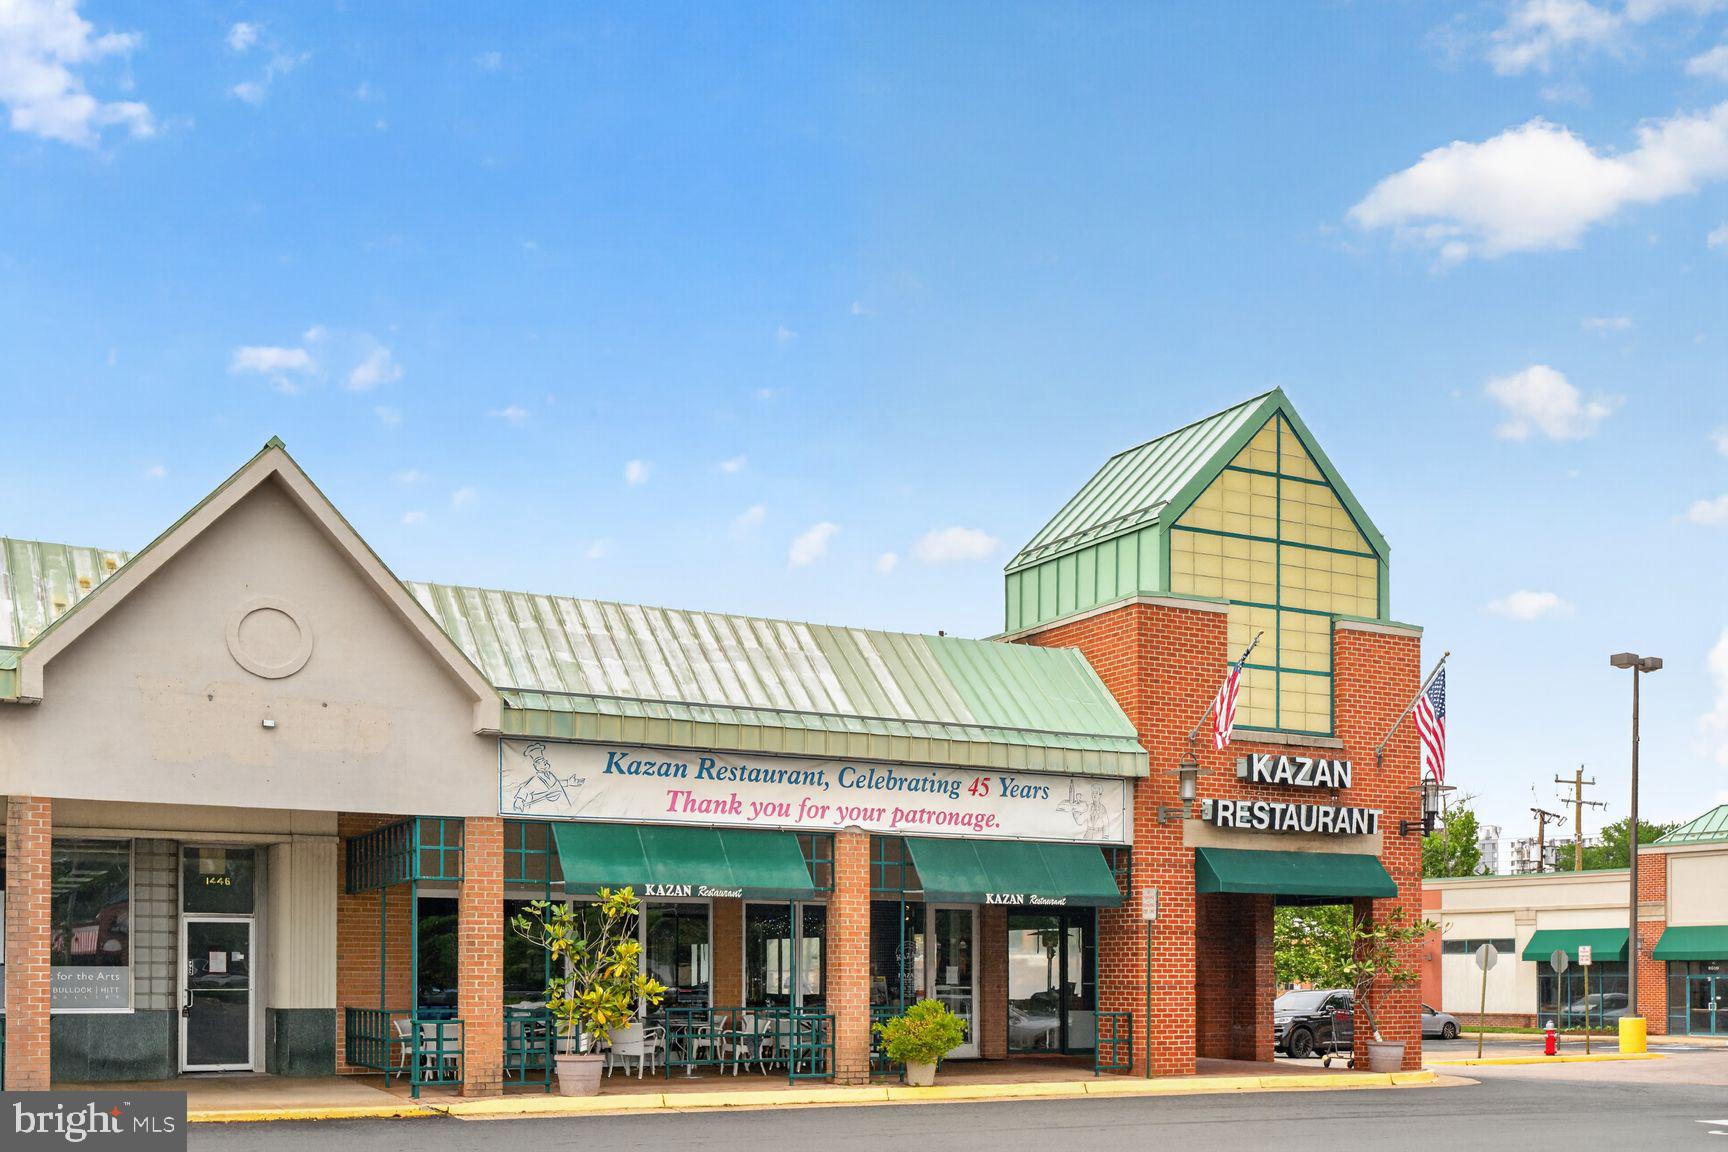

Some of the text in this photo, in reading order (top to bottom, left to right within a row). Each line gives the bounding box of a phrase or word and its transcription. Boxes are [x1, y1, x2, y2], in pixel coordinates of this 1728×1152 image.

[603, 751, 1050, 800] Kazan Restaurant, Celebrating 45 Years
[1252, 753, 1351, 788] KAZAN
[666, 790, 1000, 832] Thank you for your patronage.
[1217, 799, 1383, 834] RESTAURANT
[206, 877, 231, 885] 1446
[645, 884, 743, 898] KAZAN Restaurant
[985, 893, 1067, 906] KAZAN Restaurant
[57, 971, 73, 981] for
[77, 971, 94, 981] the
[97, 971, 120, 981] Arts
